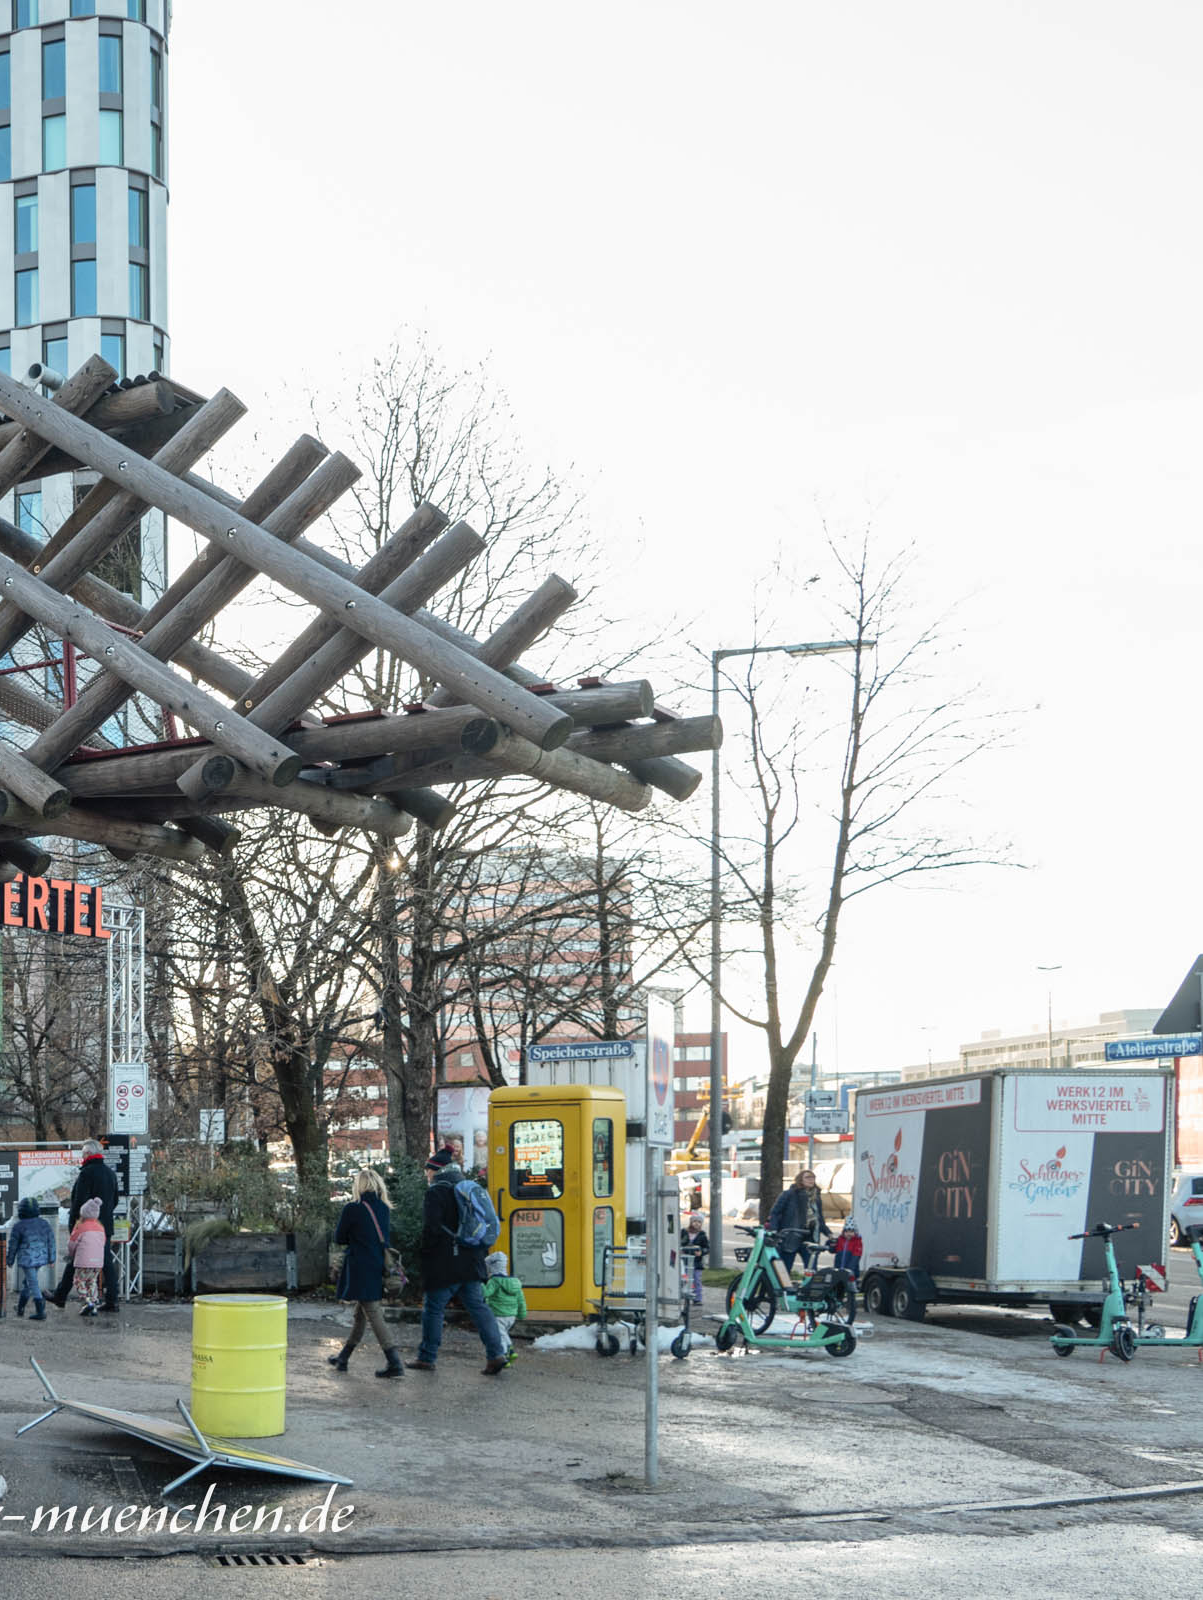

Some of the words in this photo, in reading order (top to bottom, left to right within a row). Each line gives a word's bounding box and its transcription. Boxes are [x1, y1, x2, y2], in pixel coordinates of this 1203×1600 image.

[532, 1043, 630, 1060] Speicherstraße
[1115, 1038, 1197, 1057] Atelierstraße
[1056, 1086, 1105, 1098] WERK12
[1109, 1086, 1124, 1098] IM
[1047, 1100, 1133, 1112] WERKSVIERTEL
[1071, 1113, 1107, 1125] MITTE
[1109, 1178, 1159, 1197] CITY
[934, 1187, 977, 1219] CITY
[515, 1212, 541, 1223] NEU
